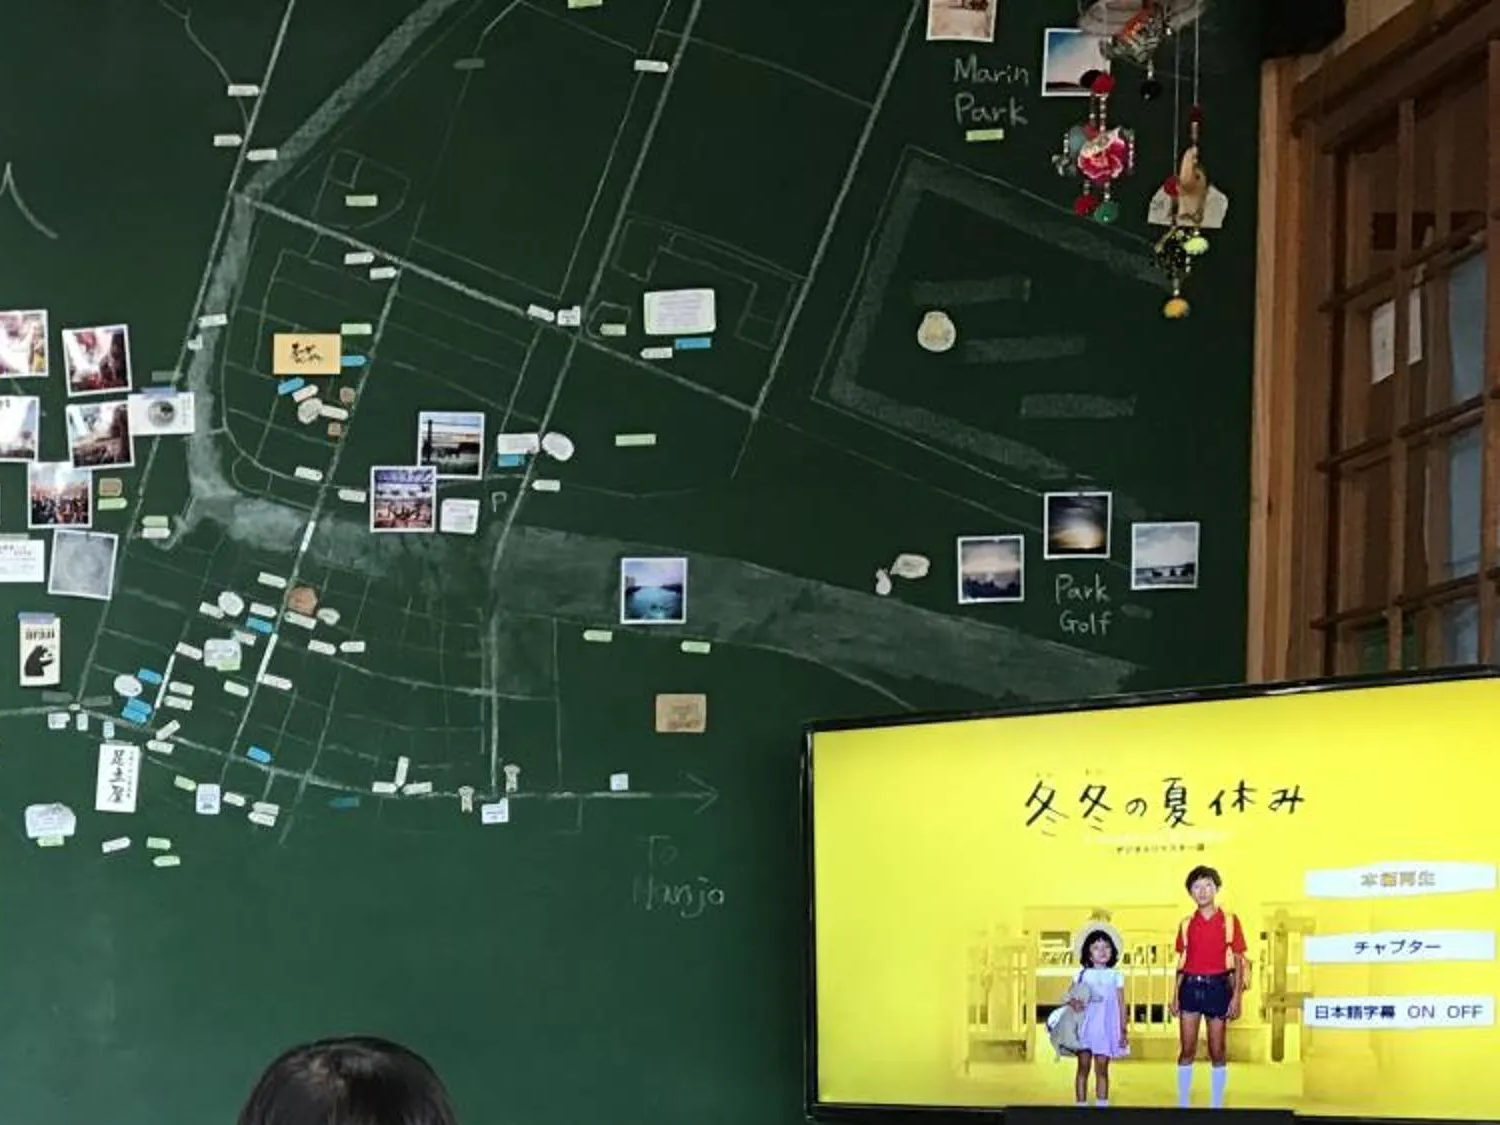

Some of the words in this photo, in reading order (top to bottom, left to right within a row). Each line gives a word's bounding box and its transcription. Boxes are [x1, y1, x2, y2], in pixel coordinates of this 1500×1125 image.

[953, 53, 1030, 86] Marin
[955, 92, 1029, 127] Park
[1055, 573, 1112, 605] Park
[1060, 609, 1113, 636] Golf
[1024, 776, 1305, 837] 冬冬の夏休み
[1354, 938, 1442, 956] チャプター
[1314, 1004, 1396, 1021] 日本語字幕
[1406, 1004, 1436, 1020] ON
[1446, 1004, 1484, 1020] OFF
